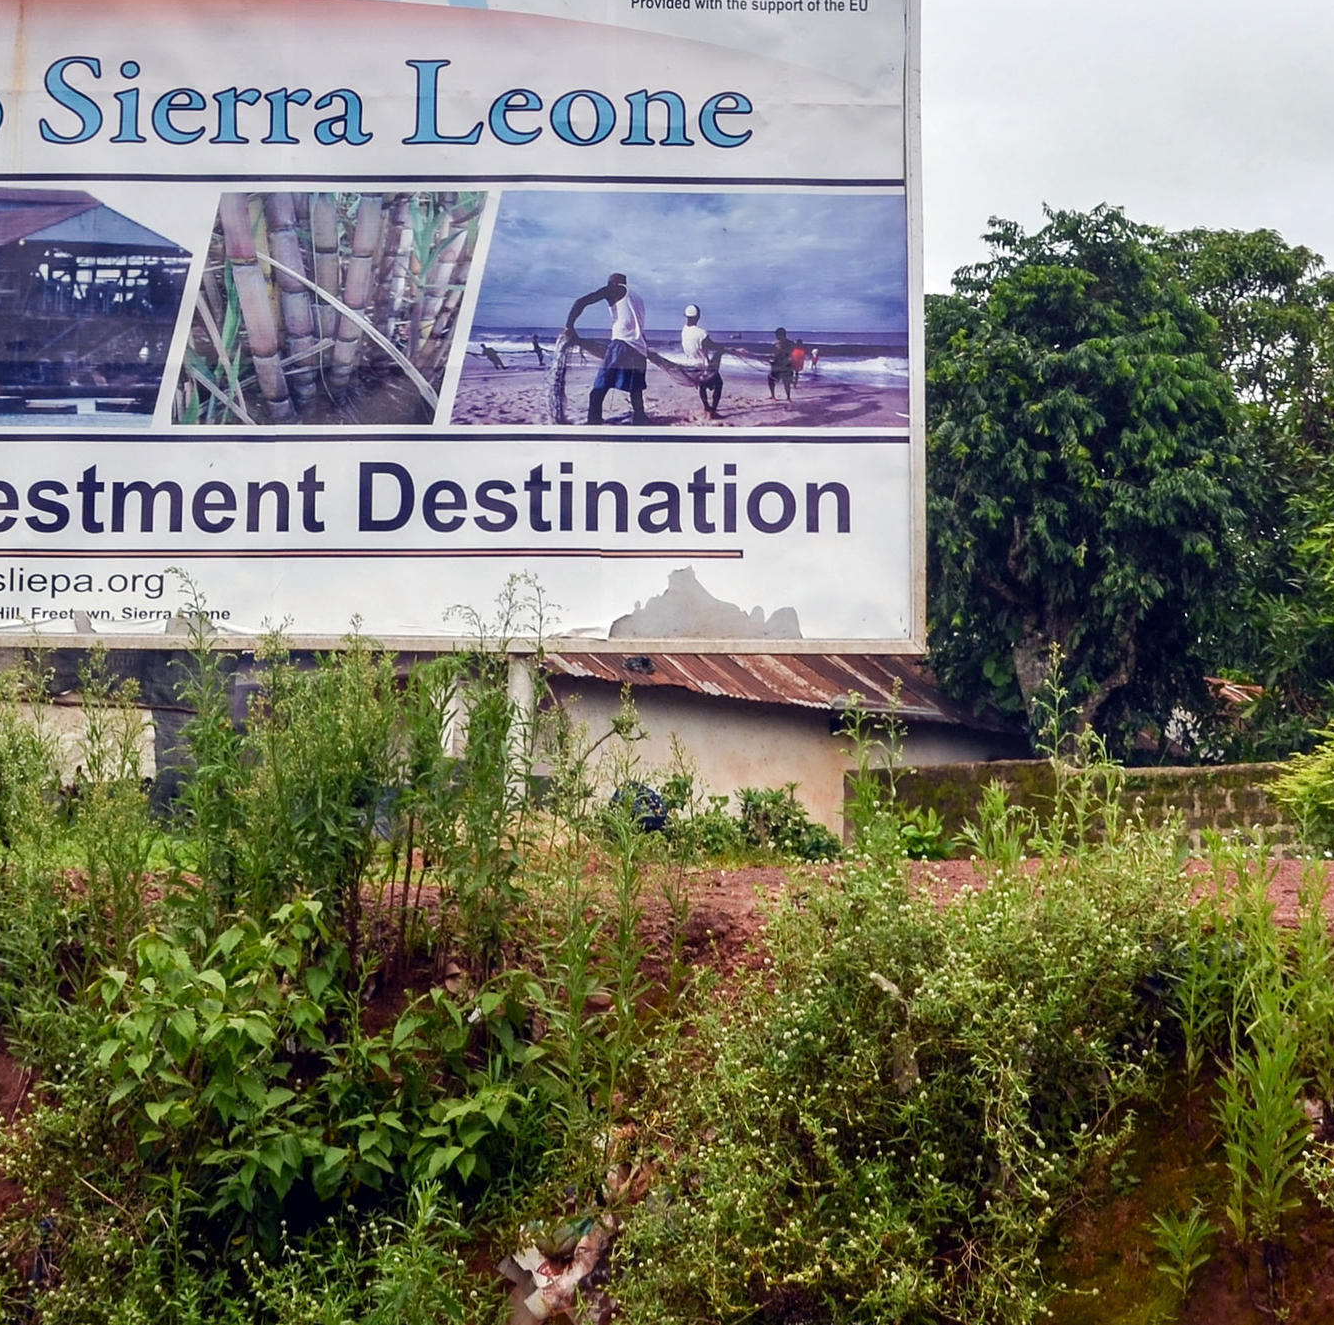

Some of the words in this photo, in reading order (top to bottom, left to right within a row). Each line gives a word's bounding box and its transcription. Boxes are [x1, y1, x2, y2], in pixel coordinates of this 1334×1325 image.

[39, 55, 373, 146] Sierra
[401, 59, 754, 147] Leone
[358, 461, 851, 534] Destination
[31, 607, 115, 622] Freetwn,
[121, 607, 172, 620] Sierra
